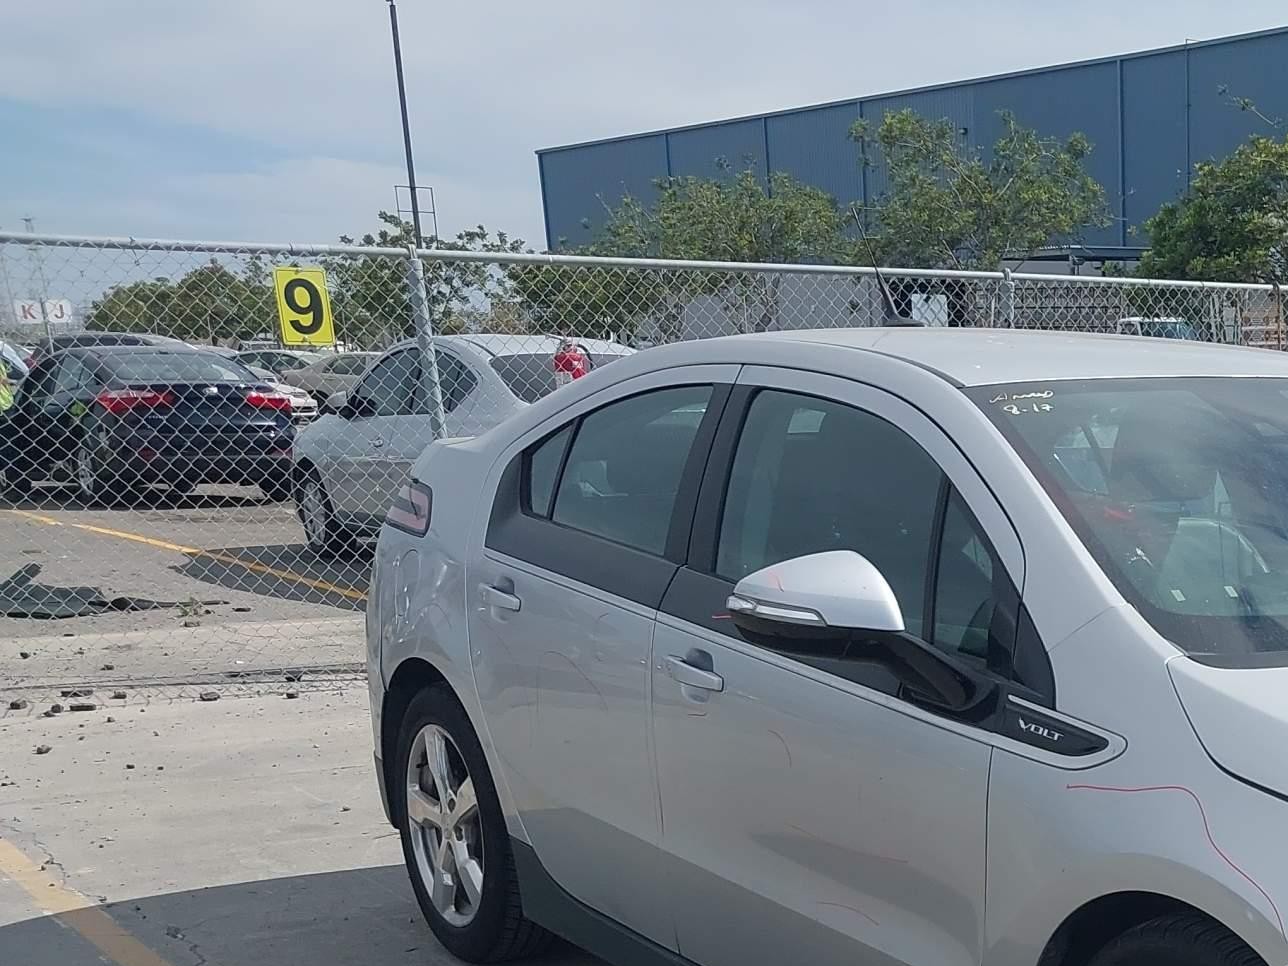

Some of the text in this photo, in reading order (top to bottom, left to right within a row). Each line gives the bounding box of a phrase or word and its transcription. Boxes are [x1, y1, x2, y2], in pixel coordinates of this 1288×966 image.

[21, 304, 37, 320] K
[54, 303, 65, 319] J
[284, 278, 324, 335] 9
[1019, 716, 1065, 741] VOLT
